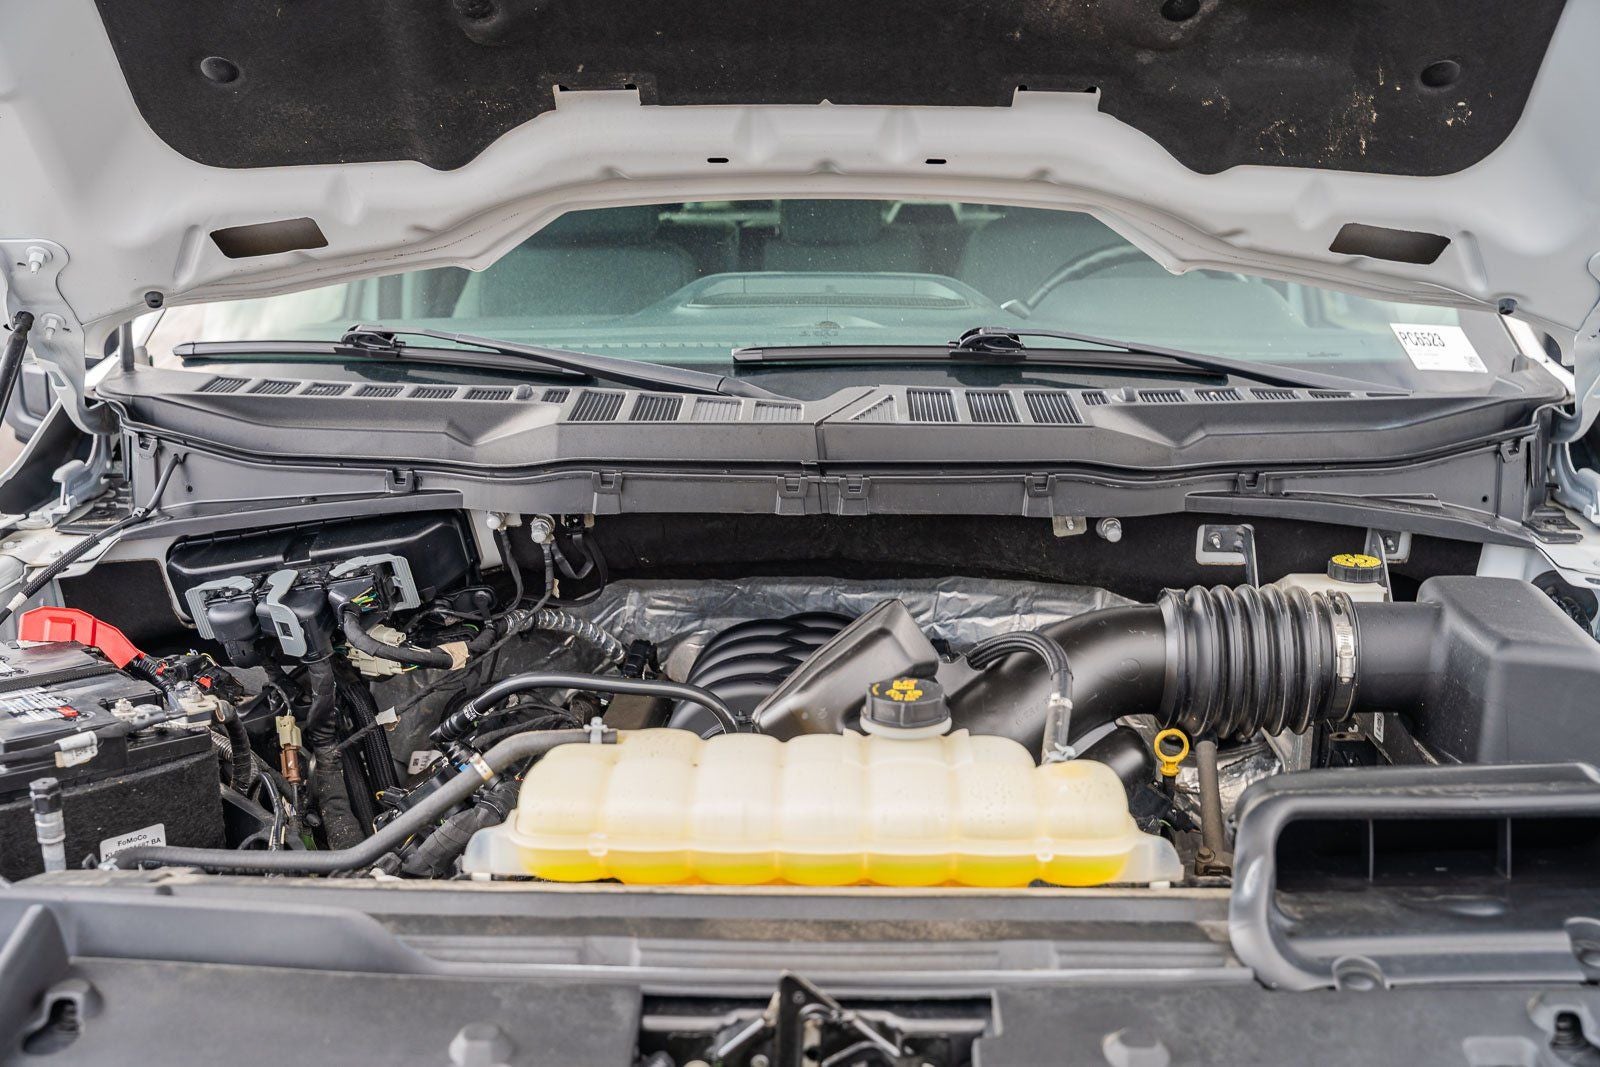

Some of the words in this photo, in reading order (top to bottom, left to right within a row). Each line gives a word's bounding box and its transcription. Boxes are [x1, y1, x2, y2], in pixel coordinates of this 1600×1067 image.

[1398, 331, 1446, 347] PC6523
[117, 834, 147, 847] FoMoCo
[151, 837, 162, 845] BA
